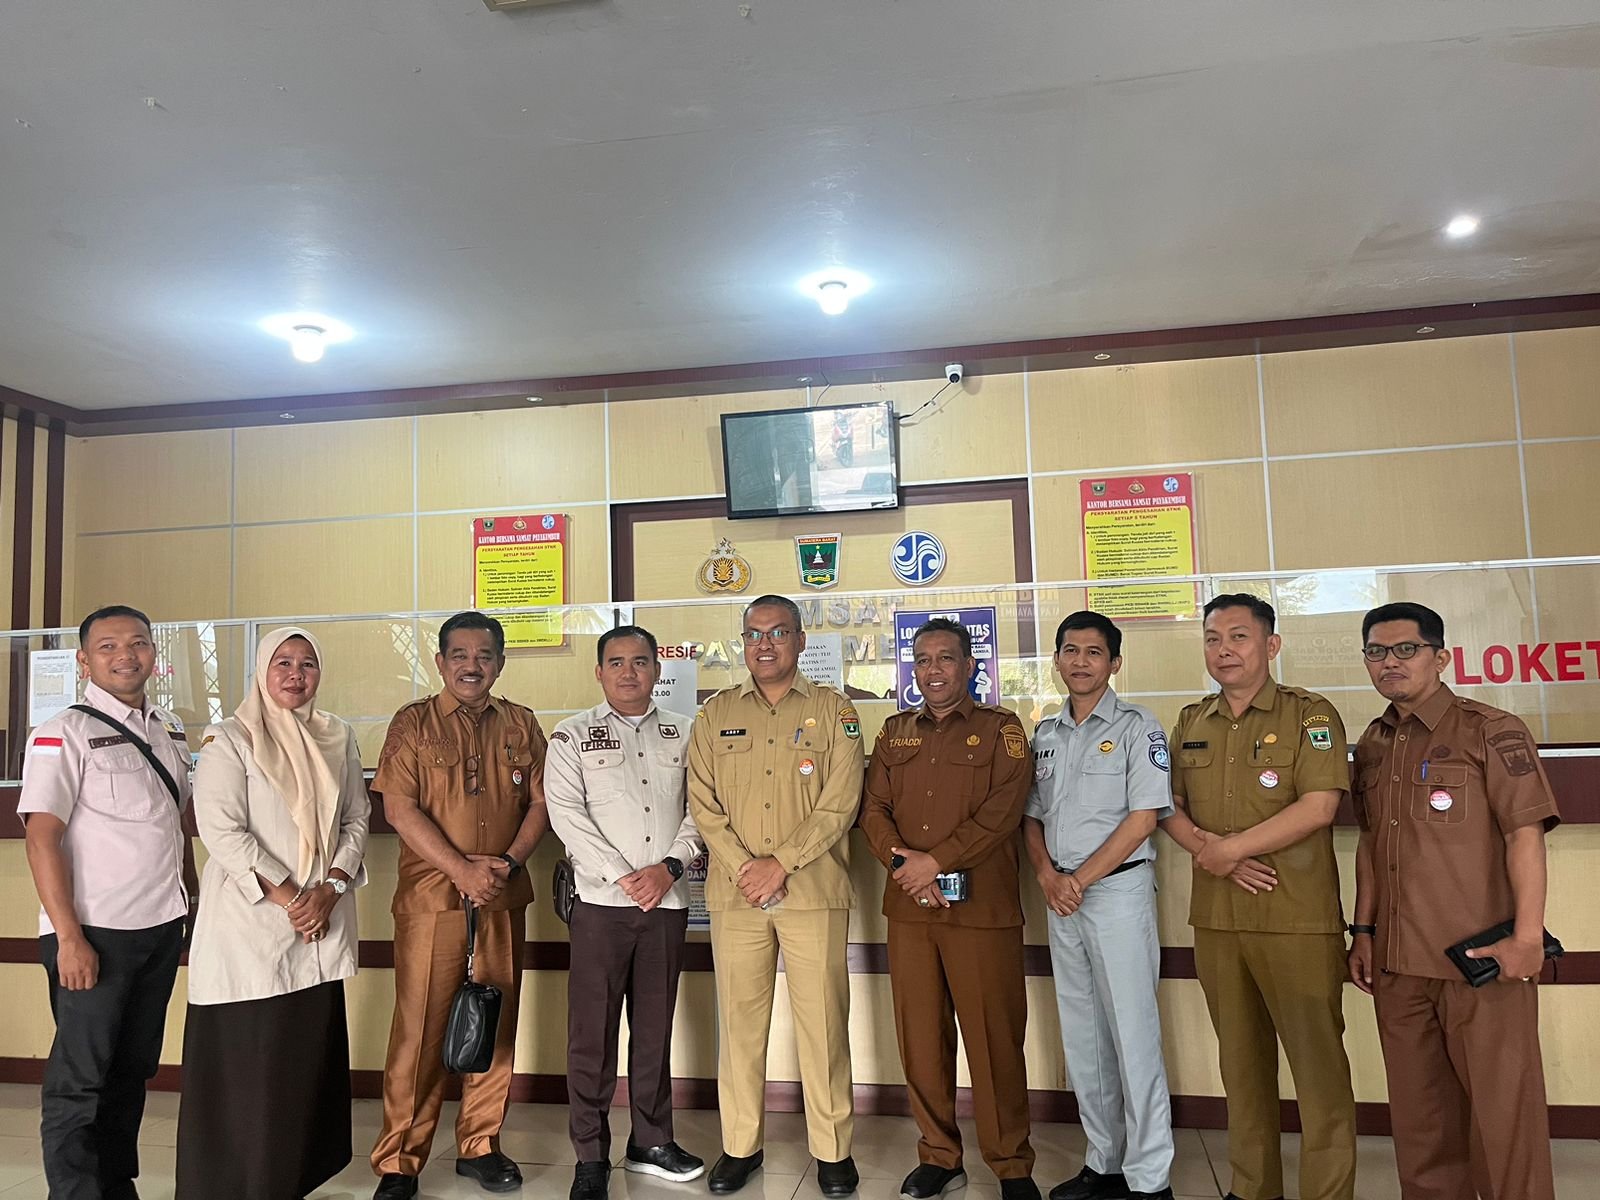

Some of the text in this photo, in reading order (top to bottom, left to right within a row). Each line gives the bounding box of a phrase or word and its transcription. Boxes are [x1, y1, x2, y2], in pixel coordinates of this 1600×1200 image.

[1086, 501, 1107, 509] KANTOR
[1108, 499, 1132, 508] BERSAMA
[1133, 497, 1151, 506] SAMSAT
[900, 627, 920, 640] LOK
